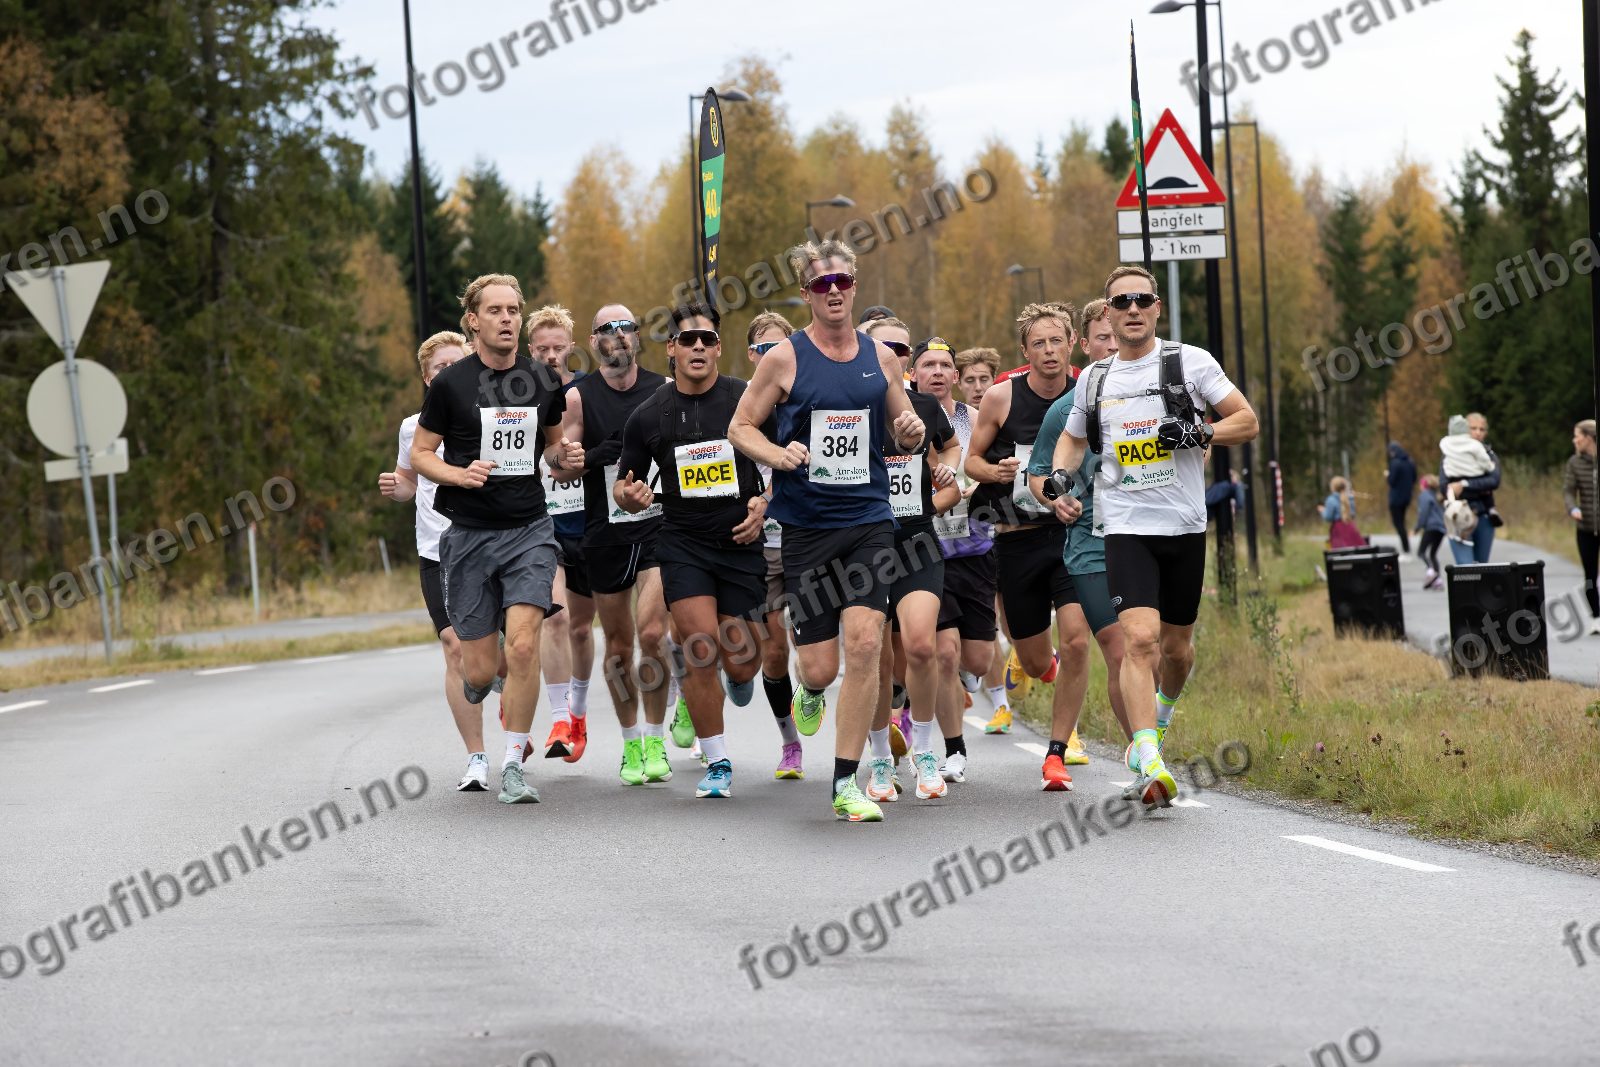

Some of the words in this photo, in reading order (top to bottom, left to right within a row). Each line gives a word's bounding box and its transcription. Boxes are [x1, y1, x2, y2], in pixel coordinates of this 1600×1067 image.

[1150, 213, 1204, 229] angfelt
[1170, 242, 1175, 254] 1
[1180, 242, 1201, 254] km
[494, 411, 528, 419] NORGES
[826, 415, 862, 423] NORGES
[829, 422, 856, 430] LØPET
[1120, 418, 1158, 430] NORGES
[1125, 426, 1153, 437] LØPET
[492, 429, 525, 451] 818
[688, 444, 723, 455] NORGES
[822, 435, 859, 458] 384
[1118, 441, 1168, 463] PACE
[691, 451, 718, 460] LØPET
[503, 458, 533, 467] Aurskog
[886, 461, 909, 469] ØPET
[684, 463, 732, 486] PACE
[835, 466, 868, 476] Aurskog
[1141, 468, 1174, 481] Aurskog
